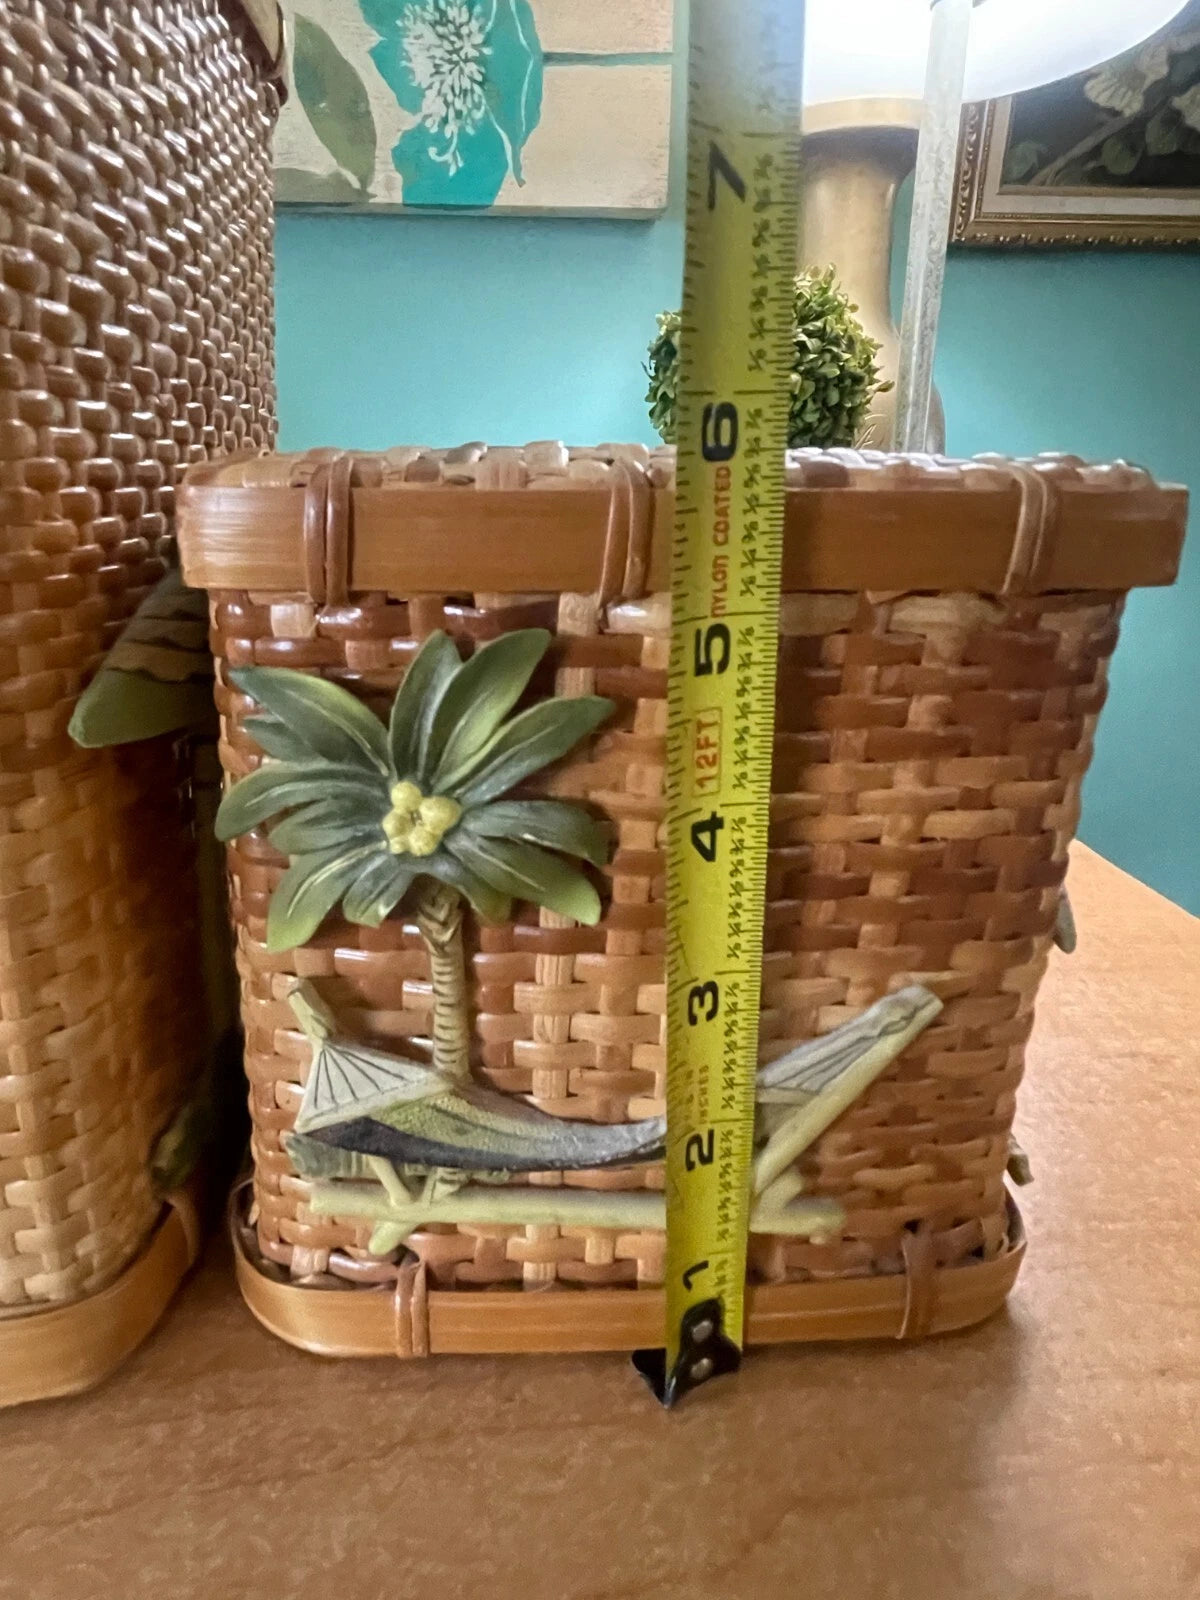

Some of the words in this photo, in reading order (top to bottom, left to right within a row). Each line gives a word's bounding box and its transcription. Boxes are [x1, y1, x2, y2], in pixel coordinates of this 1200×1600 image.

[707, 141, 745, 211] 7
[702, 401, 738, 462] 6
[713, 466, 731, 546] COATED
[694, 624, 730, 676] 5
[696, 719, 718, 788] 12FT
[691, 811, 724, 862] 4
[688, 981, 719, 1026] 3
[685, 1129, 714, 1171] 2
[683, 1260, 709, 1291] 1
